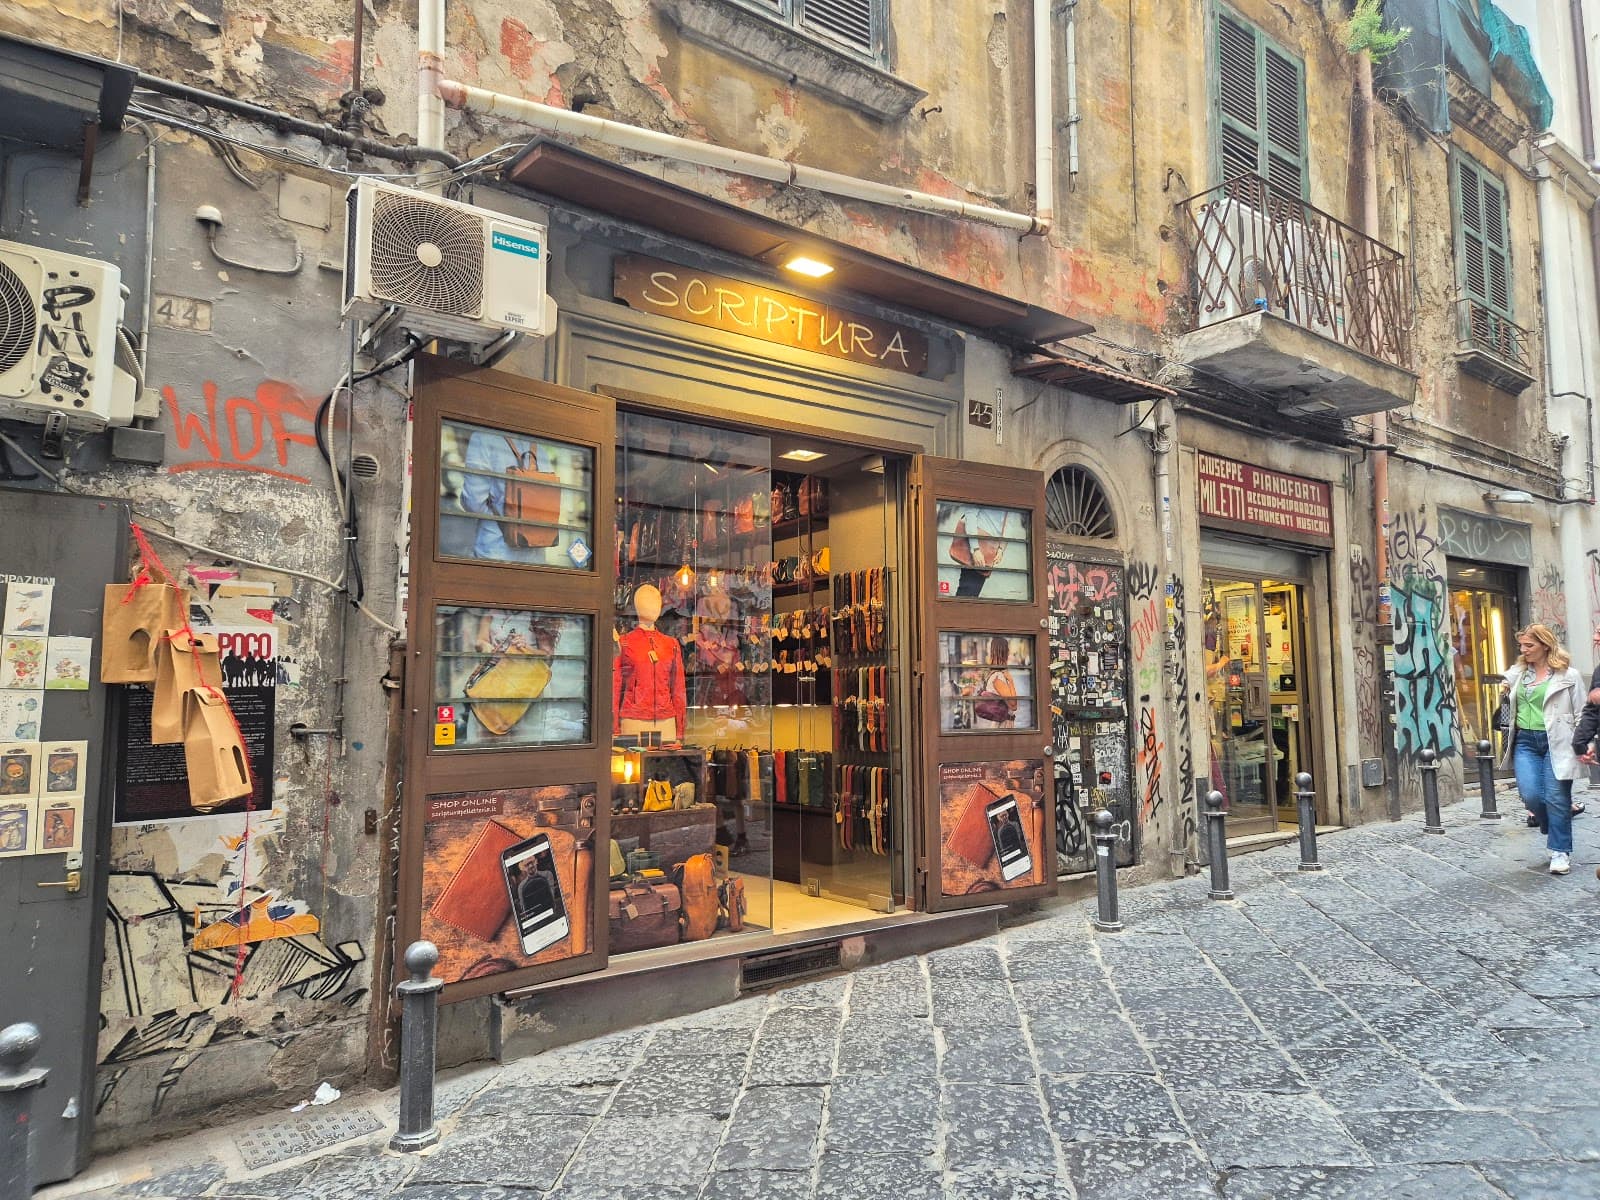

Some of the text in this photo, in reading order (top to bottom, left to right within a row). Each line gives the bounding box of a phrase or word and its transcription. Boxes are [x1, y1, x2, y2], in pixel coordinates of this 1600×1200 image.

[493, 235, 538, 254] Hisense
[642, 271, 911, 368] SCRIPTURA
[970, 403, 994, 425] 45
[1199, 454, 1244, 483] GIUSEPPE
[1200, 479, 1246, 521] MILETTI
[1252, 471, 1321, 502] PIANOFORTI
[1247, 506, 1330, 534] STRUMENTI MUSICALI
[431, 797, 497, 810] SHOP ONLINE
[431, 806, 497, 819] scripturapelletteria.it
